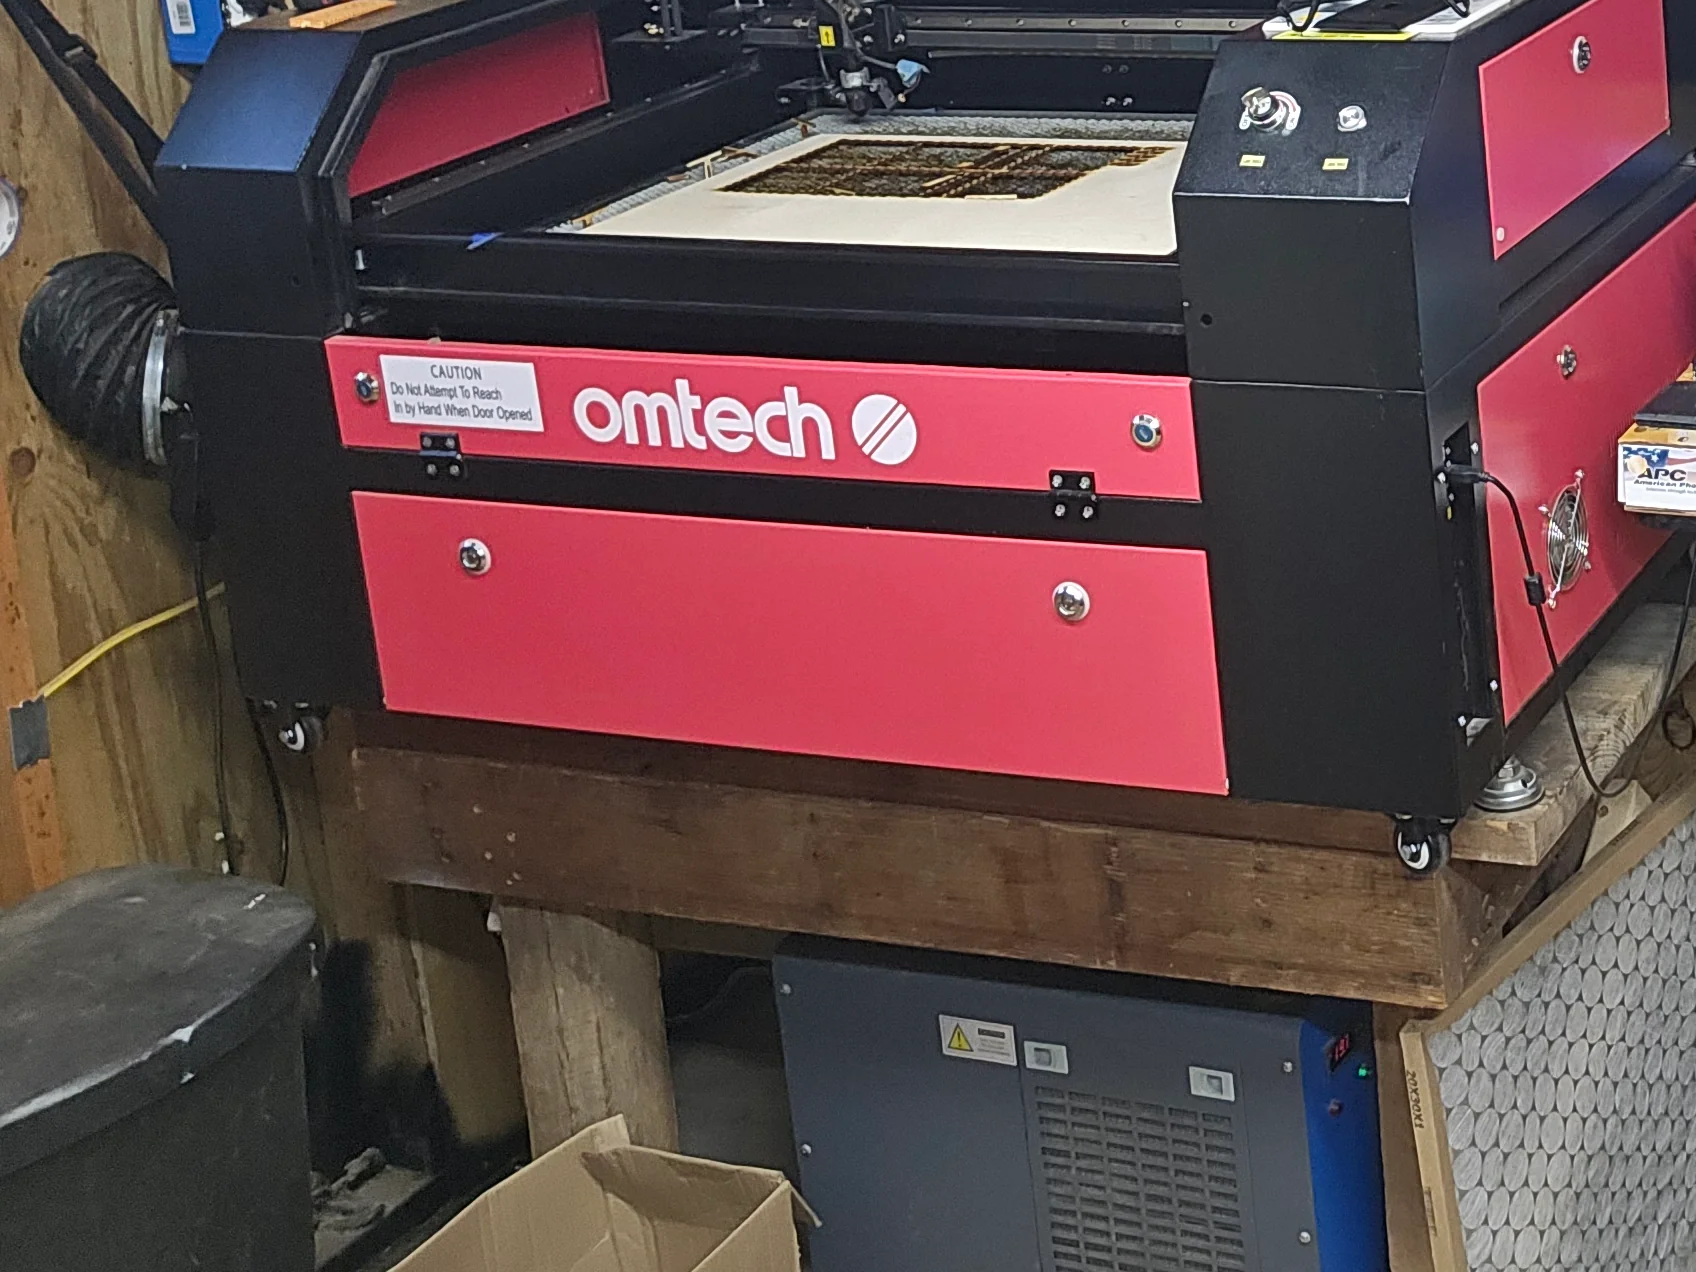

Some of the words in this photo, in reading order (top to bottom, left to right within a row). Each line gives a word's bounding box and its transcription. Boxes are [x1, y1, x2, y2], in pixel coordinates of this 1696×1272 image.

[430, 364, 482, 380] CAUTION
[390, 382, 404, 396] Do
[405, 383, 423, 397] Not
[423, 384, 458, 400] Attempt
[459, 385, 471, 399] To
[472, 386, 503, 401] Reach
[394, 401, 403, 414] In
[404, 401, 416, 417] by
[418, 402, 442, 416] Hand
[443, 404, 471, 418] When
[472, 408, 494, 418] Door
[496, 407, 533, 422] Opened
[573, 379, 836, 460] omtech
[1637, 467, 1687, 482] APC
[1633, 479, 1677, 488] American
